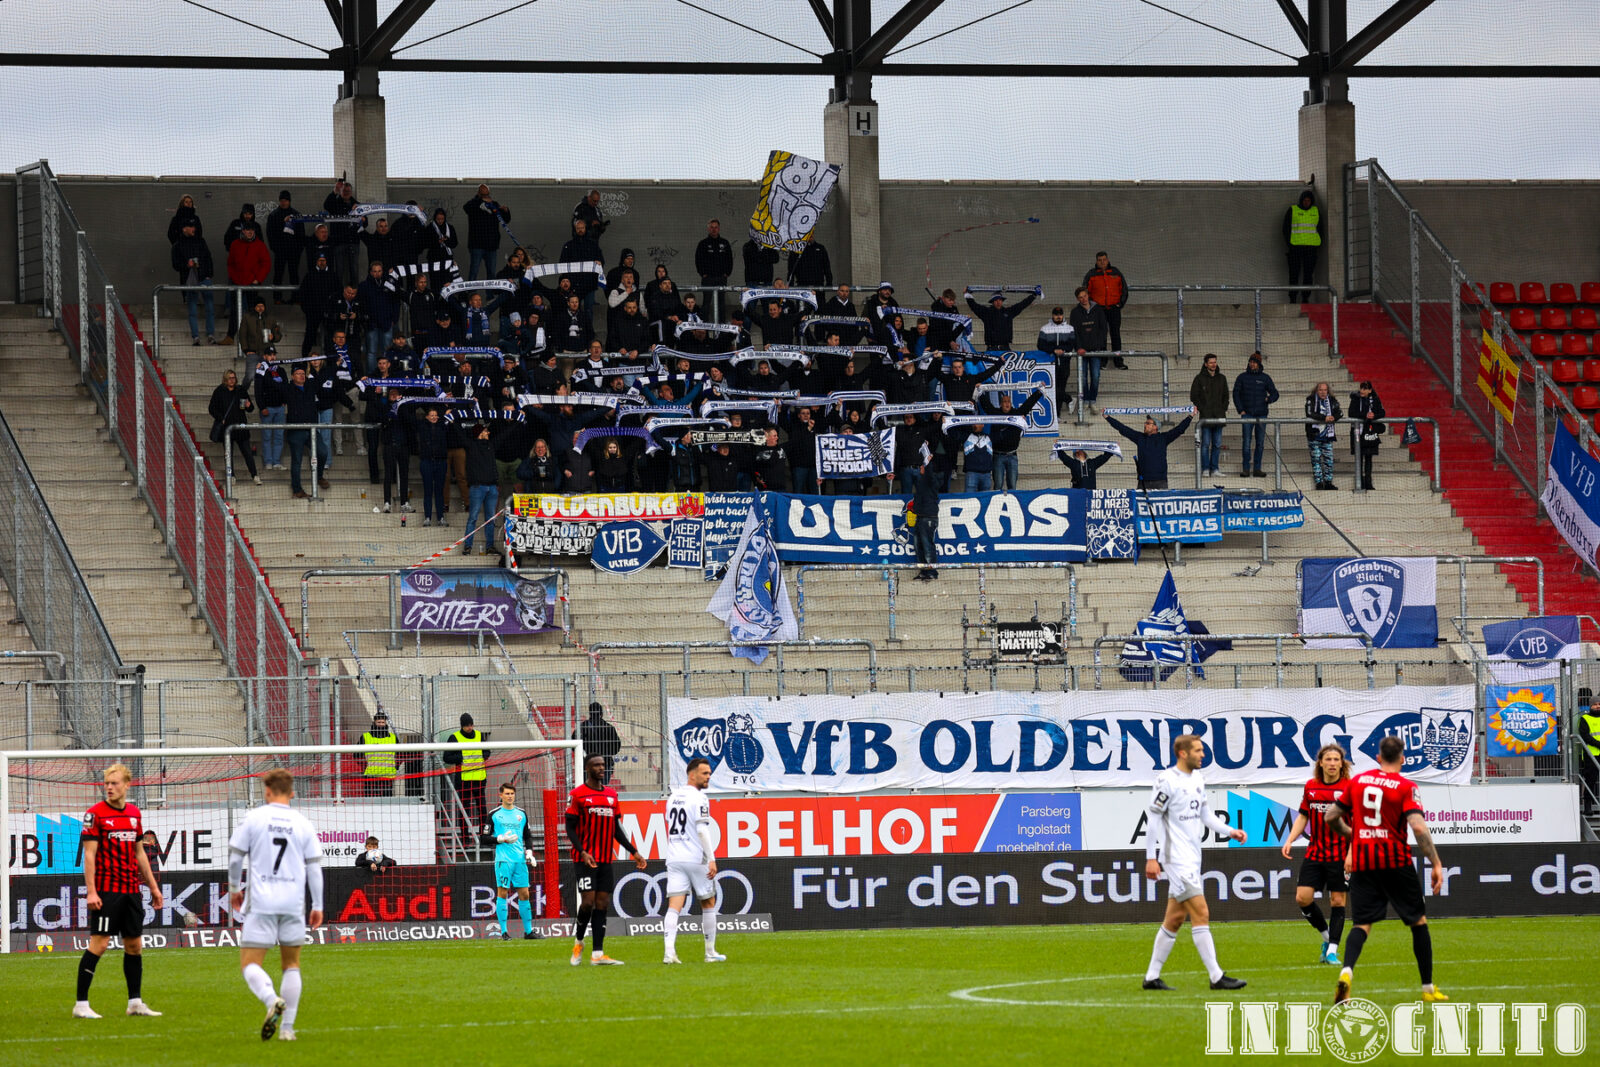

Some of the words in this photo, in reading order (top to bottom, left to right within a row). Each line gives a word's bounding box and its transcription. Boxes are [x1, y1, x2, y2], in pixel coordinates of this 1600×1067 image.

[856, 111, 871, 130] H
[1003, 352, 1035, 371] Blue
[820, 437, 846, 449] PRO
[823, 449, 863, 462] NEUES
[823, 459, 873, 473] STADION
[1091, 499, 1102, 509] NO
[1104, 498, 1130, 509] NAZIS
[1138, 499, 1218, 516] ENTOURAGE
[1228, 500, 1252, 510] LOVE
[1253, 497, 1300, 509] FOOTBALL
[726, 506, 748, 516] back
[788, 493, 1070, 541] ULTRAS
[1091, 509, 1112, 520] ONLY
[705, 520, 714, 529] to
[716, 518, 729, 529] the
[1140, 517, 1219, 535] ULTRAS
[1227, 516, 1255, 527] HATE
[1257, 513, 1304, 526] FASCISM
[674, 523, 700, 536] KEEP
[515, 534, 593, 552] OLDENBUR
[601, 528, 643, 555] VfB
[676, 536, 697, 549] THE
[608, 558, 640, 569] ULTRAS
[671, 550, 700, 563] FAITH
[1338, 560, 1401, 580] Oldenburg
[1356, 572, 1385, 583] Block
[403, 599, 509, 630] CRITTERS
[999, 629, 1015, 639] FÜR
[1015, 630, 1044, 639] IMMER
[1000, 638, 1046, 651] MATHIS
[1519, 635, 1548, 656] VfB
[767, 720, 898, 777] VfB
[919, 713, 1354, 774] OLDENBURG
[1020, 804, 1071, 818] Parsberg
[1363, 786, 1384, 827] 9
[668, 807, 687, 836] 29
[1437, 809, 1468, 822] deine
[1469, 808, 1534, 823] Ausbildung!
[268, 824, 293, 835] Brand
[613, 807, 958, 861] MBELHOF
[1016, 823, 1072, 837] Ingolstadt
[1428, 823, 1522, 835] ww.azubimovie.de
[316, 830, 369, 844] sbildung!
[996, 841, 1072, 852] moebelhof.de
[272, 837, 288, 875] 7
[578, 876, 592, 891] 42
[793, 866, 888, 909] Für
[907, 865, 1019, 907] den
[339, 885, 452, 922] Audi
[98, 916, 109, 932] 11
[366, 921, 475, 942] hildeGUARD
